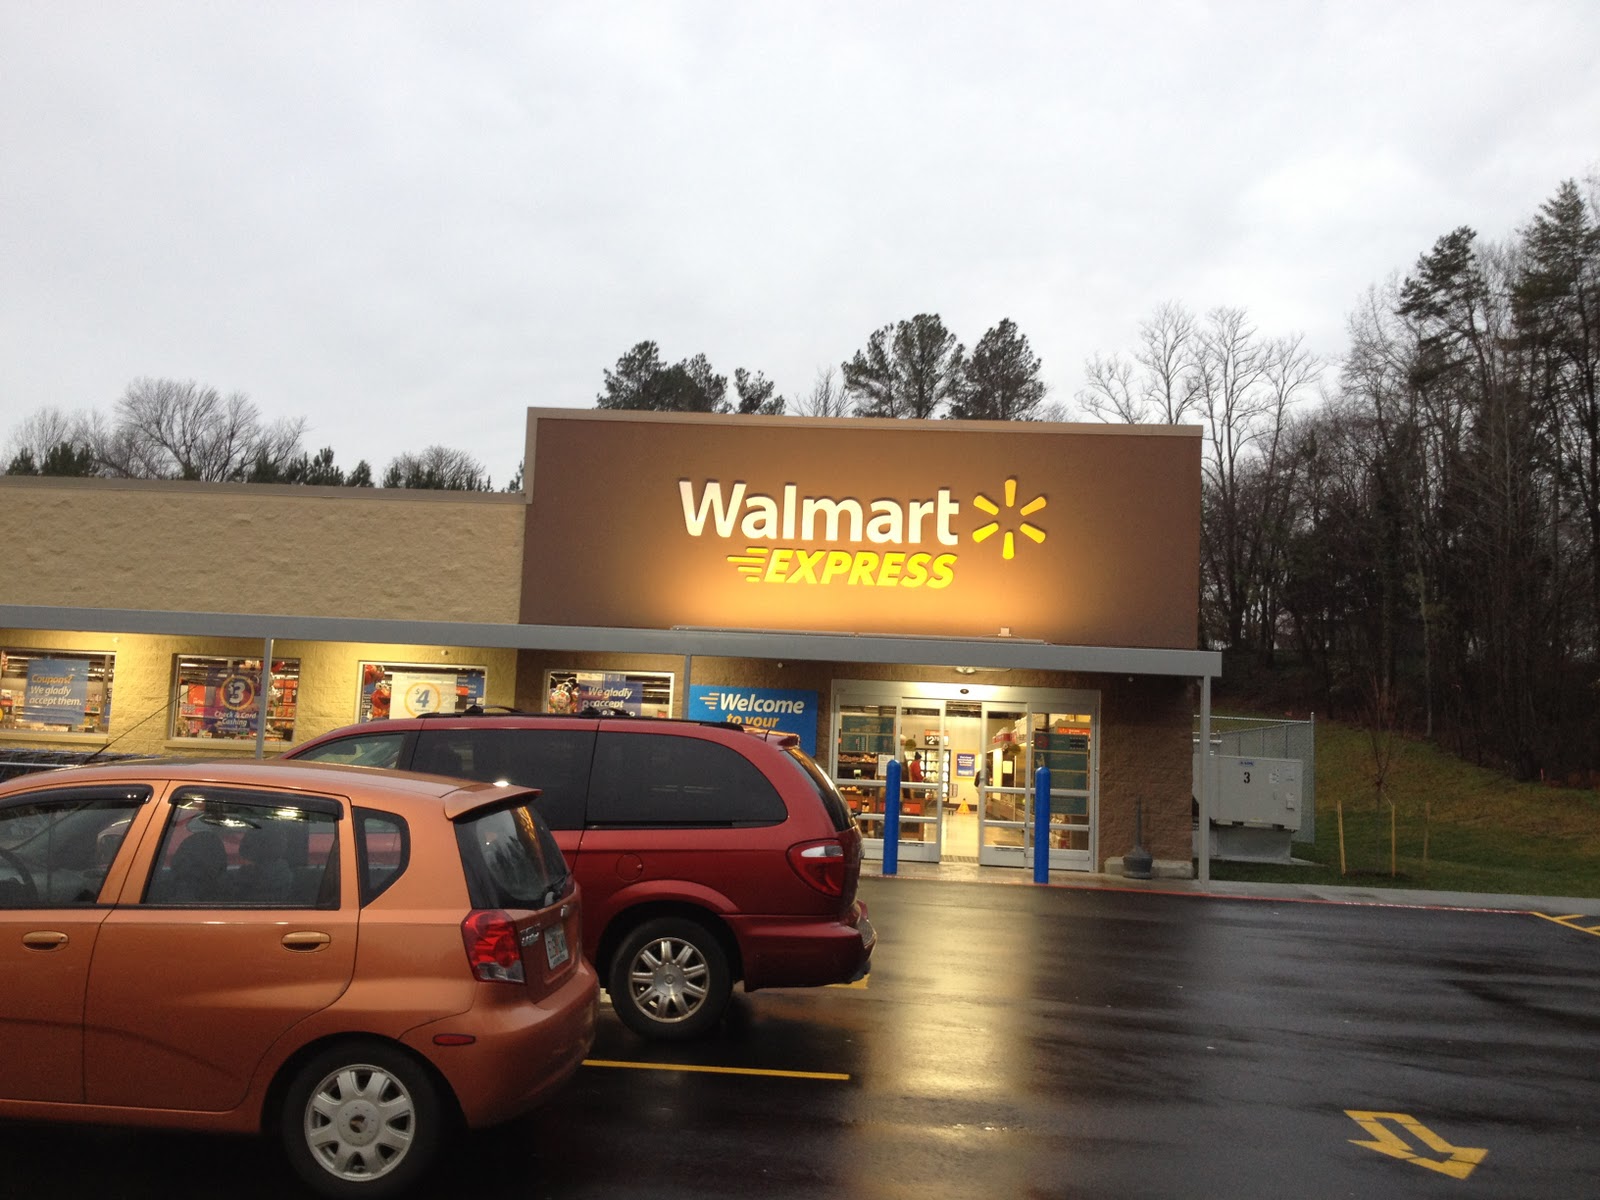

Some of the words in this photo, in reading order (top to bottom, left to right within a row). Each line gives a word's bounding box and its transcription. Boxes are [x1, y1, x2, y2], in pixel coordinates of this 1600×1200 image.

[678, 480, 960, 546] Walmart
[763, 548, 959, 590] EXPRESS
[30, 686, 44, 694] We
[45, 686, 71, 697] gladly
[588, 687, 603, 696] We
[603, 687, 633, 700] gladly
[29, 697, 56, 706] accept
[58, 697, 82, 706] them.
[720, 692, 805, 714] Welcome
[214, 710, 233, 719] Check
[726, 713, 743, 725] to
[745, 716, 780, 728] your
[221, 718, 248, 727] Cashing
[1243, 771, 1251, 784] 3
